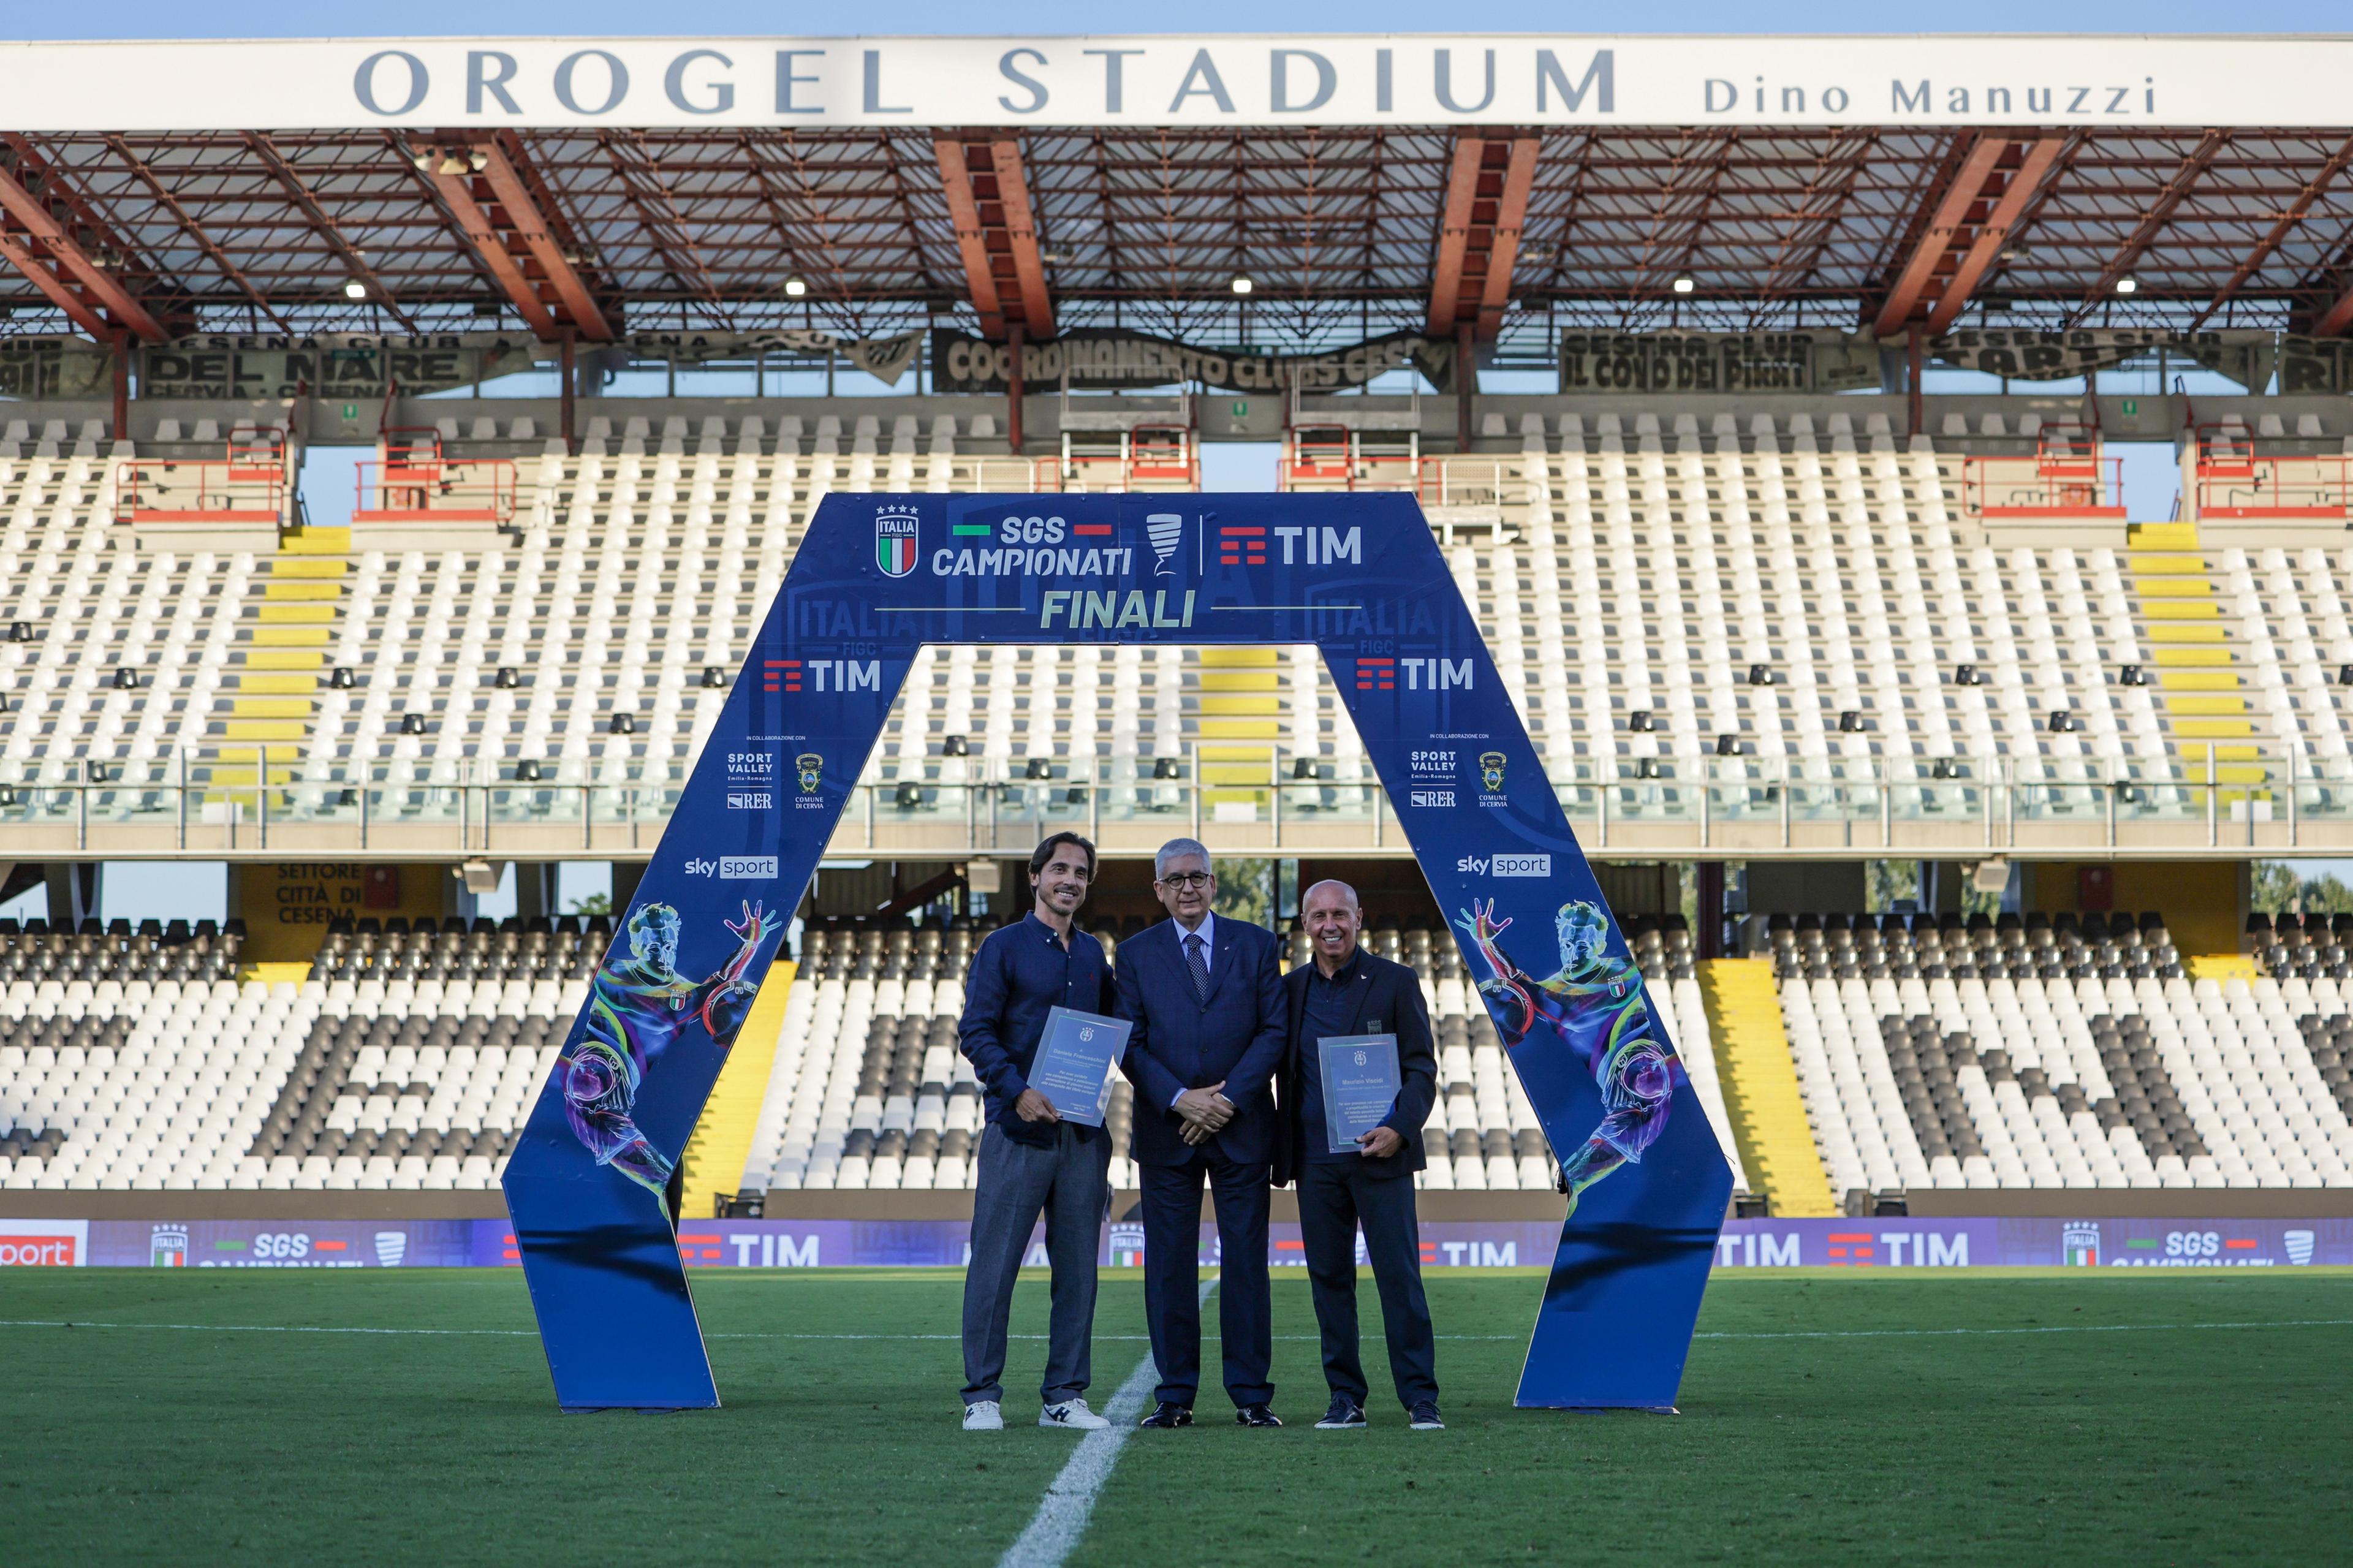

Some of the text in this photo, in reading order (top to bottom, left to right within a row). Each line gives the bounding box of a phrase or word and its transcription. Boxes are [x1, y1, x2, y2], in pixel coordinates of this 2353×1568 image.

[353, 47, 1615, 116] OROGEL STADIUM
[1703, 75, 2155, 114] Dino Manuzzi
[149, 353, 460, 381] DEL MARE
[947, 339, 1227, 385] COORDINAMENTO
[1566, 357, 1588, 387] IL
[1595, 357, 1670, 389] COVO
[1677, 357, 1716, 389] DEI
[1724, 357, 1806, 387] PIRAT
[879, 521, 915, 532] ITALIA
[1000, 516, 1066, 544] SGS
[1275, 526, 1361, 564] TIM
[932, 548, 1132, 577] CAMPIONATI
[1040, 590, 1195, 629] FINALI
[808, 660, 880, 692] TIM
[1401, 658, 1473, 690] TIM
[728, 754, 772, 763] SPORT
[1412, 752, 1456, 761] SPORT
[1412, 762, 1456, 771] VALLEY
[278, 863, 361, 879] SETTORE
[685, 858, 774, 877] sky sport
[1457, 855, 1546, 876] sky sport
[277, 883, 360, 904] CITTÀ DI
[278, 907, 358, 924] CESENA
[1053, 1048, 1073, 1057] Daniele
[1073, 1052, 1106, 1064] Franceschini
[155, 1237, 184, 1248] ITALIA
[253, 1233, 310, 1258] SGS
[729, 1234, 820, 1267] TIM
[1718, 1233, 1801, 1267] TIM
[1880, 1233, 1969, 1267] TIM
[2067, 1235, 2095, 1246] ITALIA
[2165, 1231, 2221, 1257] SGS
[1442, 1241, 1517, 1267] TIM
